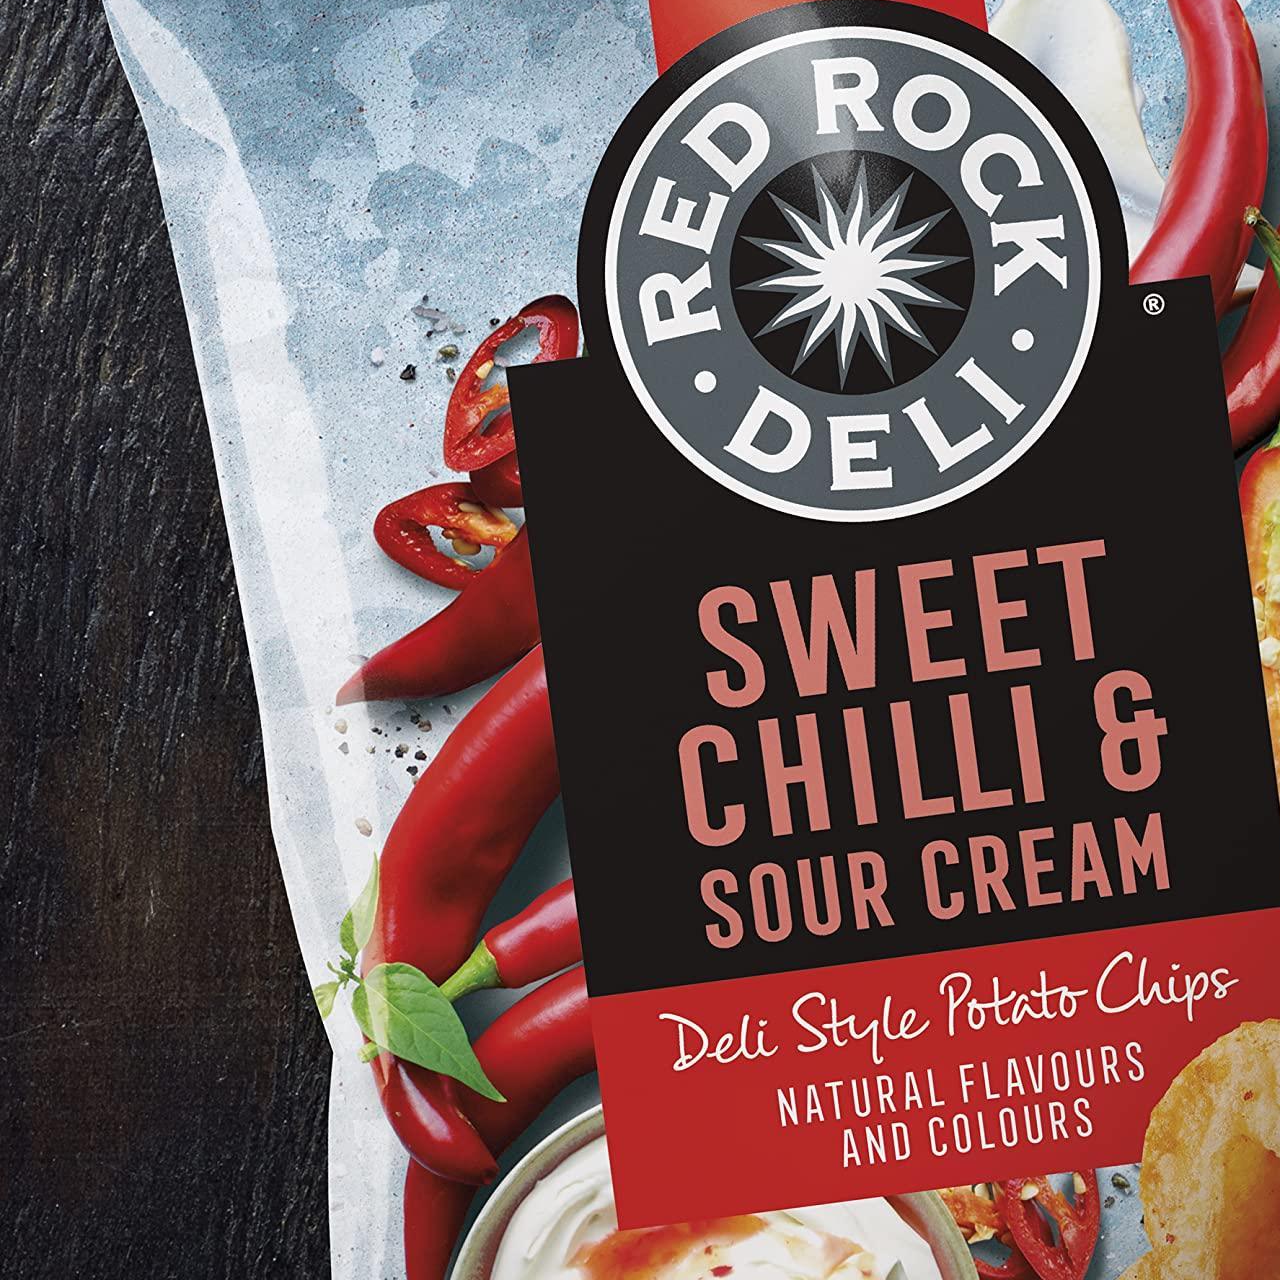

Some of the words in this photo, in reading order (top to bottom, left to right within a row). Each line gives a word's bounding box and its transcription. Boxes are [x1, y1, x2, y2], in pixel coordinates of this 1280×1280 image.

[639, 101, 771, 346] RED
[811, 56, 1068, 297] ROCK
[723, 357, 1025, 491] DELI
[697, 538, 1107, 709] SWEET
[677, 685, 1047, 848] CHILLI
[1092, 669, 1169, 793] &
[699, 850, 895, 949] SOUR
[920, 812, 1171, 920] CREAM
[659, 1012, 779, 1072] Deli
[790, 991, 930, 1065] Style
[938, 971, 1089, 1038] Potato
[1094, 950, 1240, 1022] Chips
[775, 1067, 947, 1128] NATURAL
[959, 1041, 1146, 1104] FLAVOURS
[842, 1124, 912, 1169] AND
[928, 1097, 1094, 1158] COLOURS
